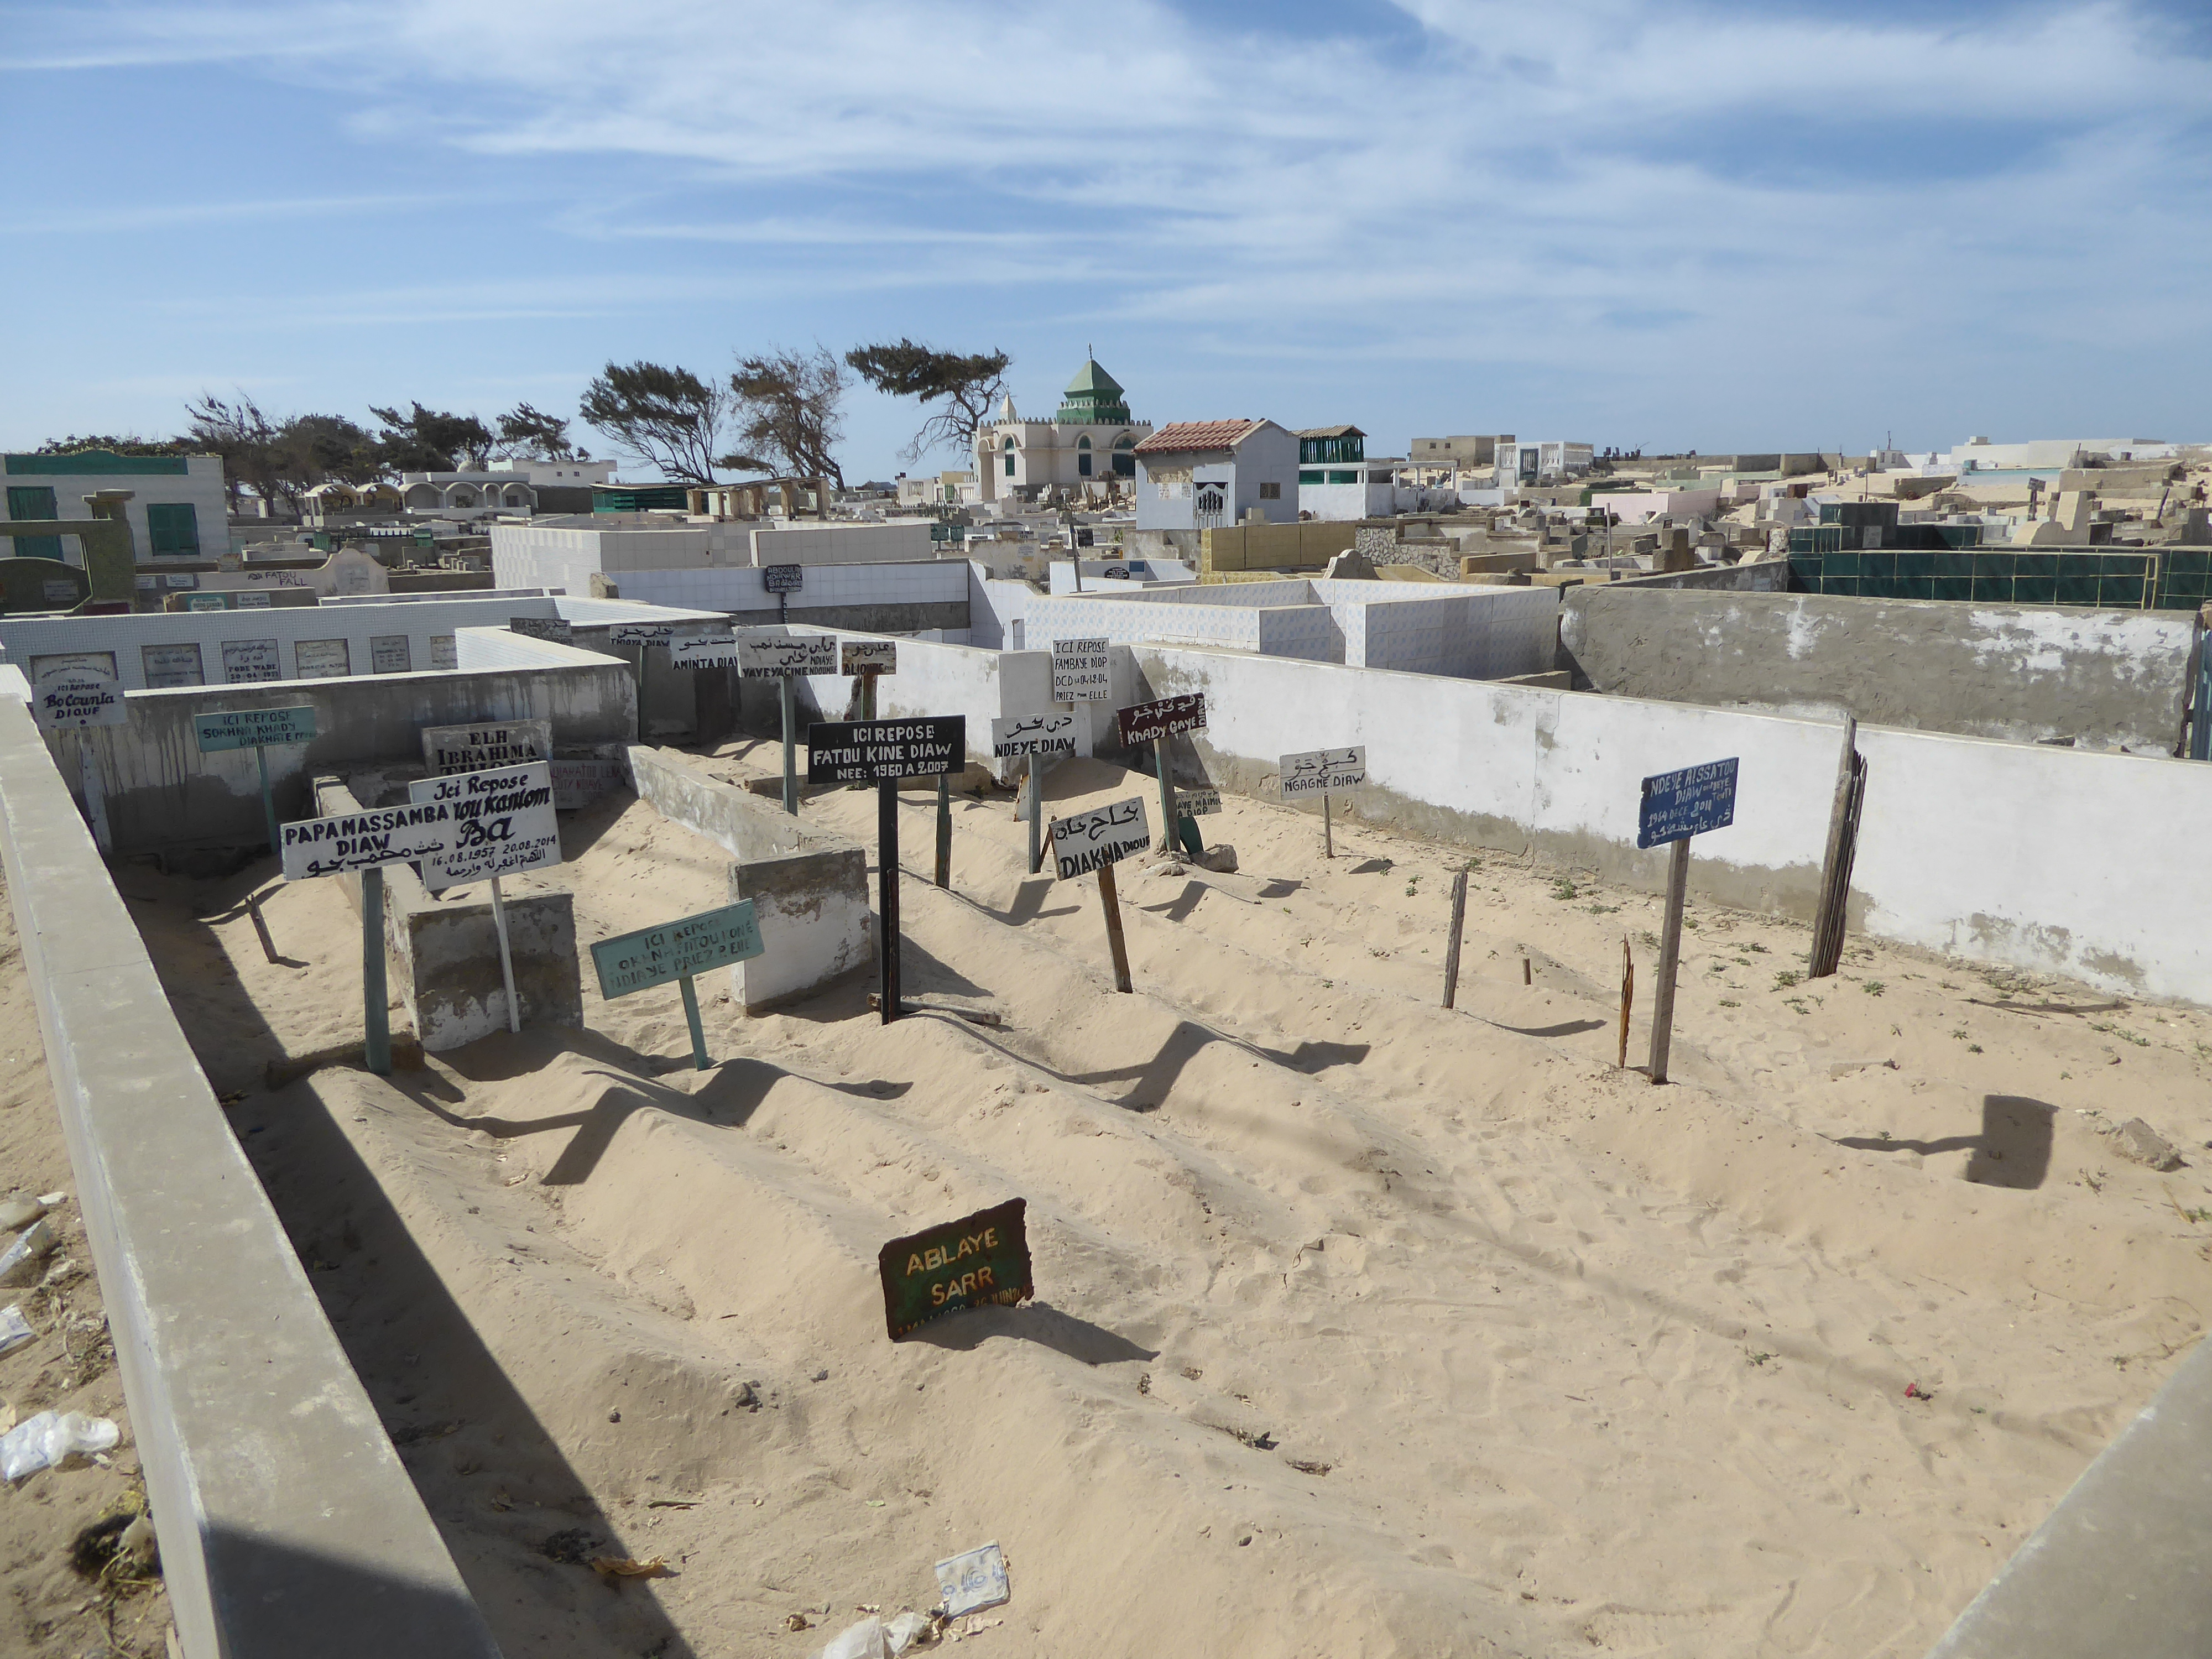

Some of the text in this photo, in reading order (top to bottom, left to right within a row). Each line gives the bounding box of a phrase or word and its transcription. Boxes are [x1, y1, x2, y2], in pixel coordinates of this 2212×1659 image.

[1055, 640, 1106, 654] ICI REPOSE
[718, 656, 737, 667] DIA
[810, 655, 834, 665] NDIAYE
[844, 663, 884, 676] ALIOE
[1055, 655, 1108, 670] FAMBAYE DIOP
[771, 666, 808, 677] YACINE
[1056, 675, 1073, 686] DCD
[1056, 690, 1074, 701] PRIEZ
[1089, 690, 1107, 700] ELLE
[223, 716, 239, 726] ICI
[1197, 698, 1206, 726] DIAW
[257, 722, 296, 735] KHADY
[853, 725, 935, 743] ICI REPOSE
[1169, 716, 1196, 733] GAYE
[469, 730, 508, 746] ELH
[994, 737, 1076, 758] NDEYE DIAW
[437, 744, 538, 765] IBRAHIMA
[813, 743, 952, 766] FATOU KINE DIAW
[837, 768, 867, 780] NEE:
[906, 763, 915, 775] A
[917, 761, 949, 775] 2007
[467, 774, 528, 796] Repose
[1285, 773, 1365, 792] NGAGNE DIAW
[1651, 771, 1682, 797] NDEYE
[1674, 785, 1703, 805] DIAW
[1178, 801, 1191, 809] AYE
[1187, 806, 1208, 816] DIOP
[456, 817, 516, 849] Ba
[336, 833, 390, 857] DIAW
[432, 835, 556, 867] 16.08.1957 20.08.2014
[1060, 841, 1124, 880] DIAKHA
[645, 919, 720, 950] ICI REPO
[674, 949, 713, 971] PRIEZ
[906, 1227, 998, 1276] ABLAYE
[931, 1266, 994, 1307] SARR
